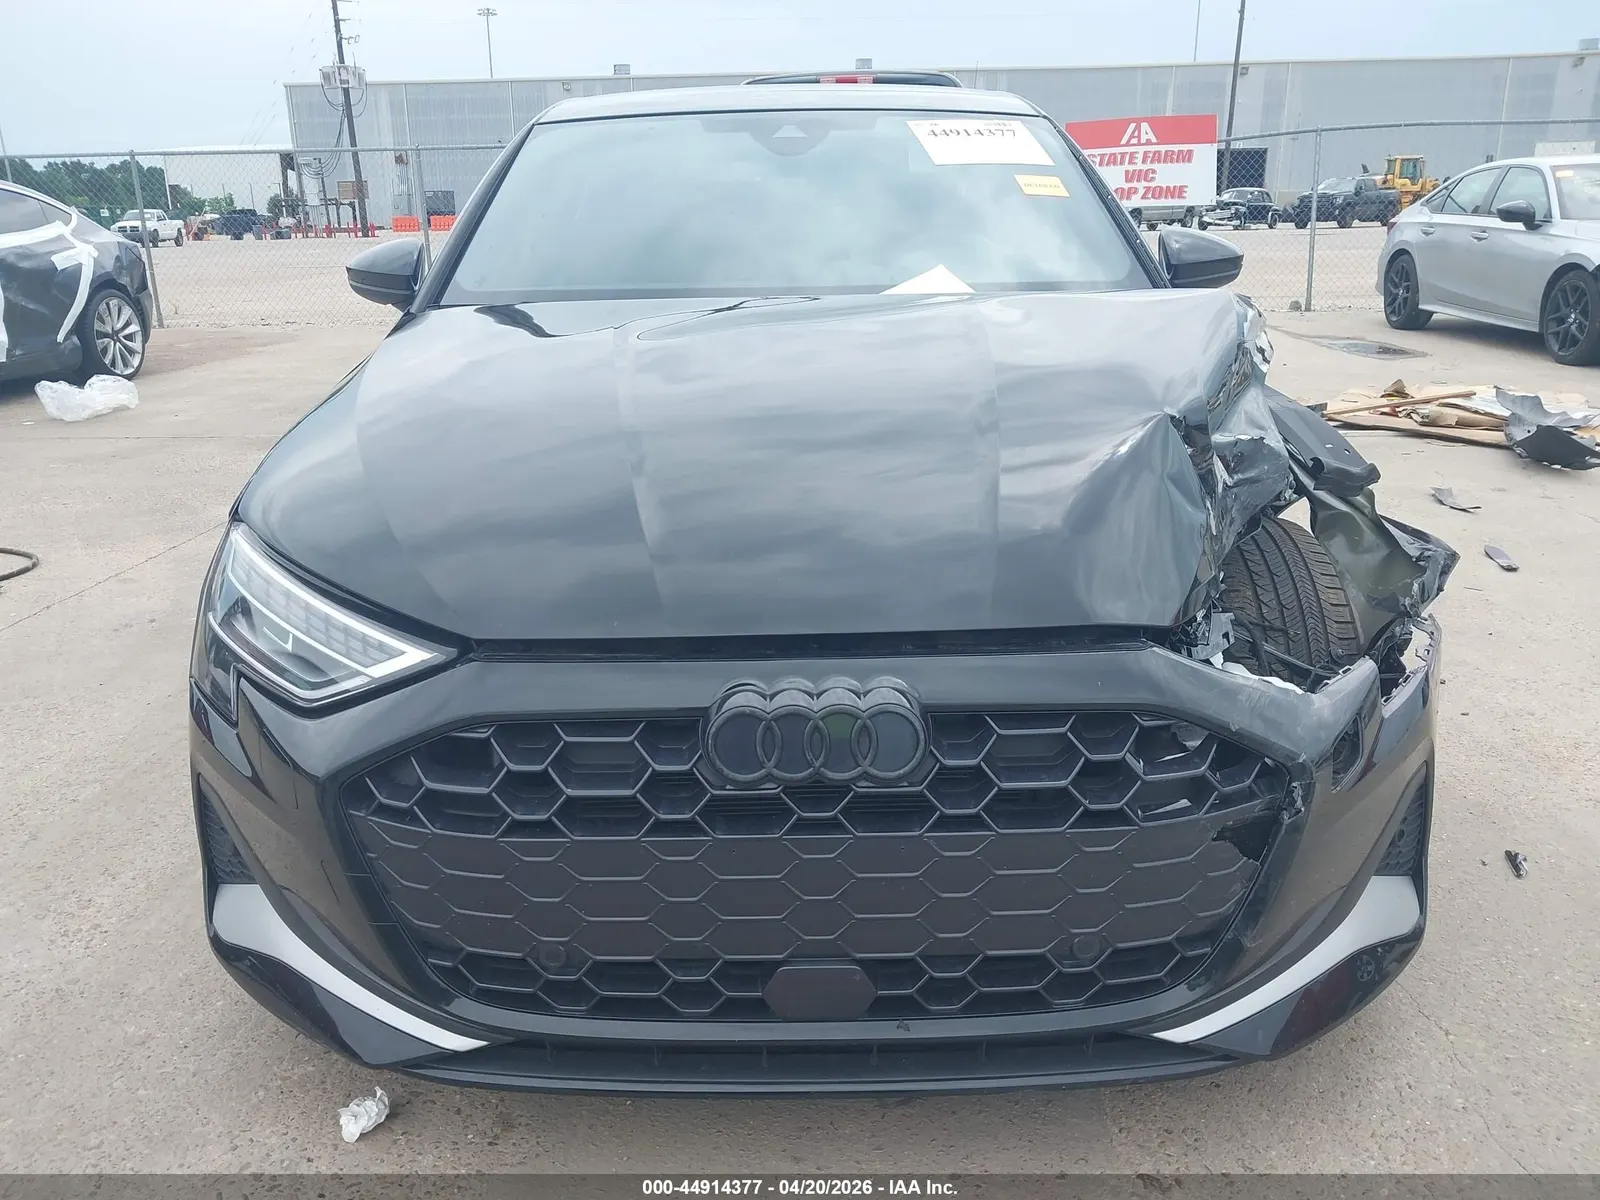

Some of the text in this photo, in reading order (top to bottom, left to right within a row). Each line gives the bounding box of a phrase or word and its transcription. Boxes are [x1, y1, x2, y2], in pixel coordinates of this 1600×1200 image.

[927, 128, 1017, 138] 44914377
[1086, 148, 1195, 168] STATE FARM
[1124, 168, 1158, 184] VIC
[1140, 184, 1189, 201] ZONE
